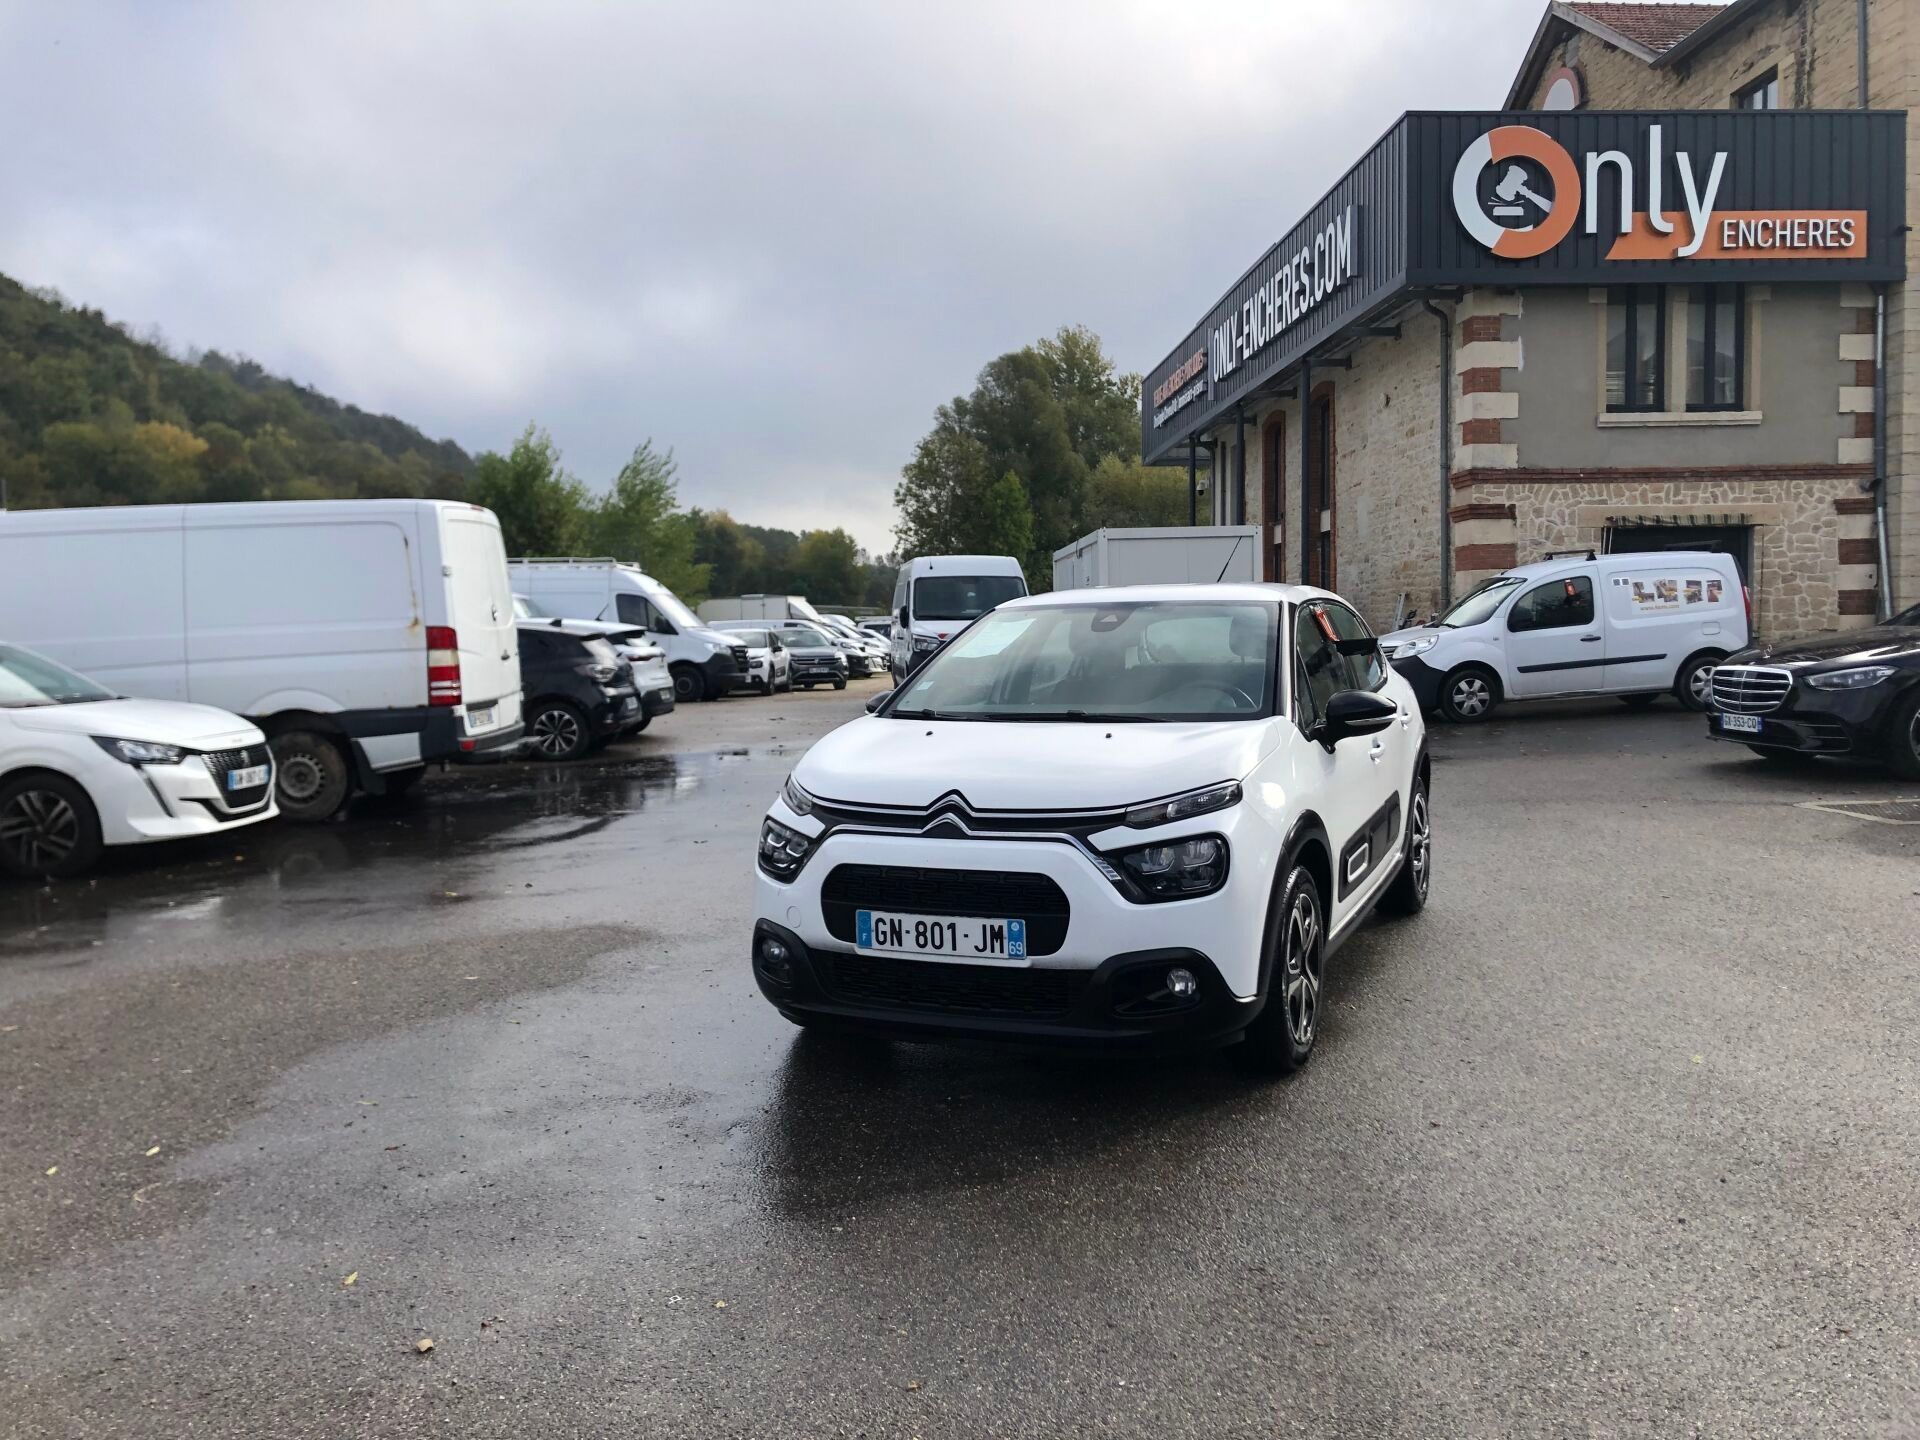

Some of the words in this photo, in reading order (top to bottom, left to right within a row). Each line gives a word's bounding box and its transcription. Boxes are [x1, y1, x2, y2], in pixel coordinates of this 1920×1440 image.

[1453, 125, 1728, 258] Only
[1722, 218, 1856, 248] ENCHERES
[1212, 204, 1353, 383] ONLY-ENCHERES.COM
[874, 917, 1005, 954] GN-801-JM
[1008, 941, 1023, 955] 69
